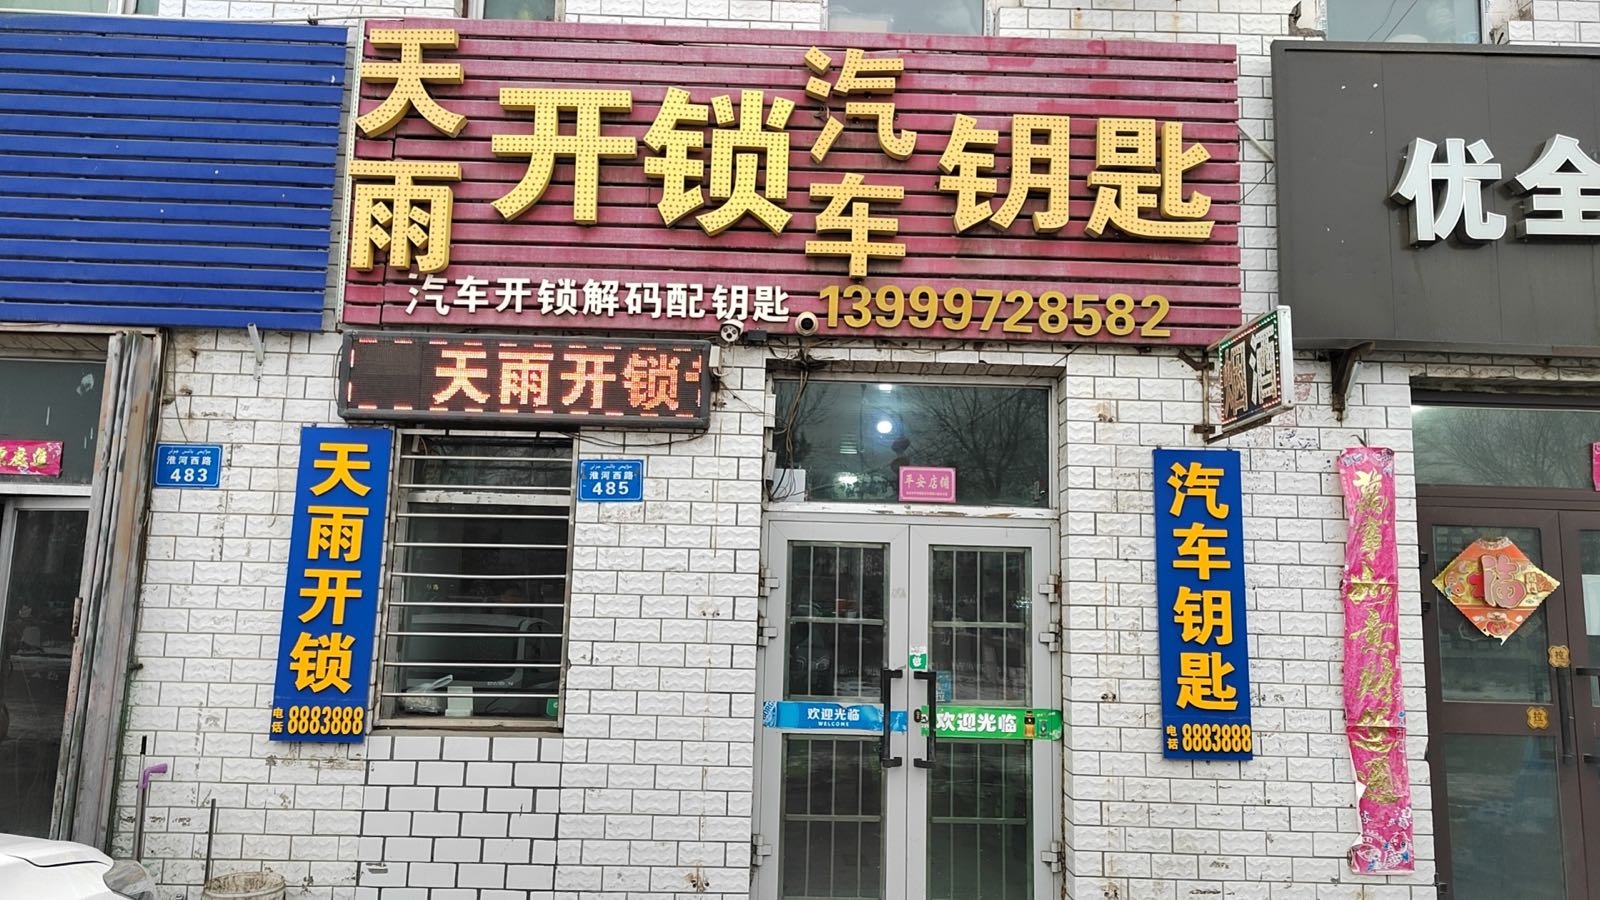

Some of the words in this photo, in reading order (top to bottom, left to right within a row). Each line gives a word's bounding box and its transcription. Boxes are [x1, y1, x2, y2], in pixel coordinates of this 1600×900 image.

[938, 113, 1215, 240] 钥匙
[405, 273, 791, 323] 汽车开锁解码配钥匙
[818, 284, 1171, 338] 13999728582
[170, 467, 210, 483] 483
[592, 481, 629, 496] 485
[289, 442, 372, 694] 天雨开锁
[1166, 462, 1239, 711] 汽车钥匙
[271, 707, 284, 733] 电话
[287, 705, 365, 735] 8883888
[807, 708, 860, 722] 欢迎光临
[936, 712, 1017, 733] 欢迎光临
[1166, 724, 1178, 750] 电话
[1182, 723, 1251, 752] 8883888
